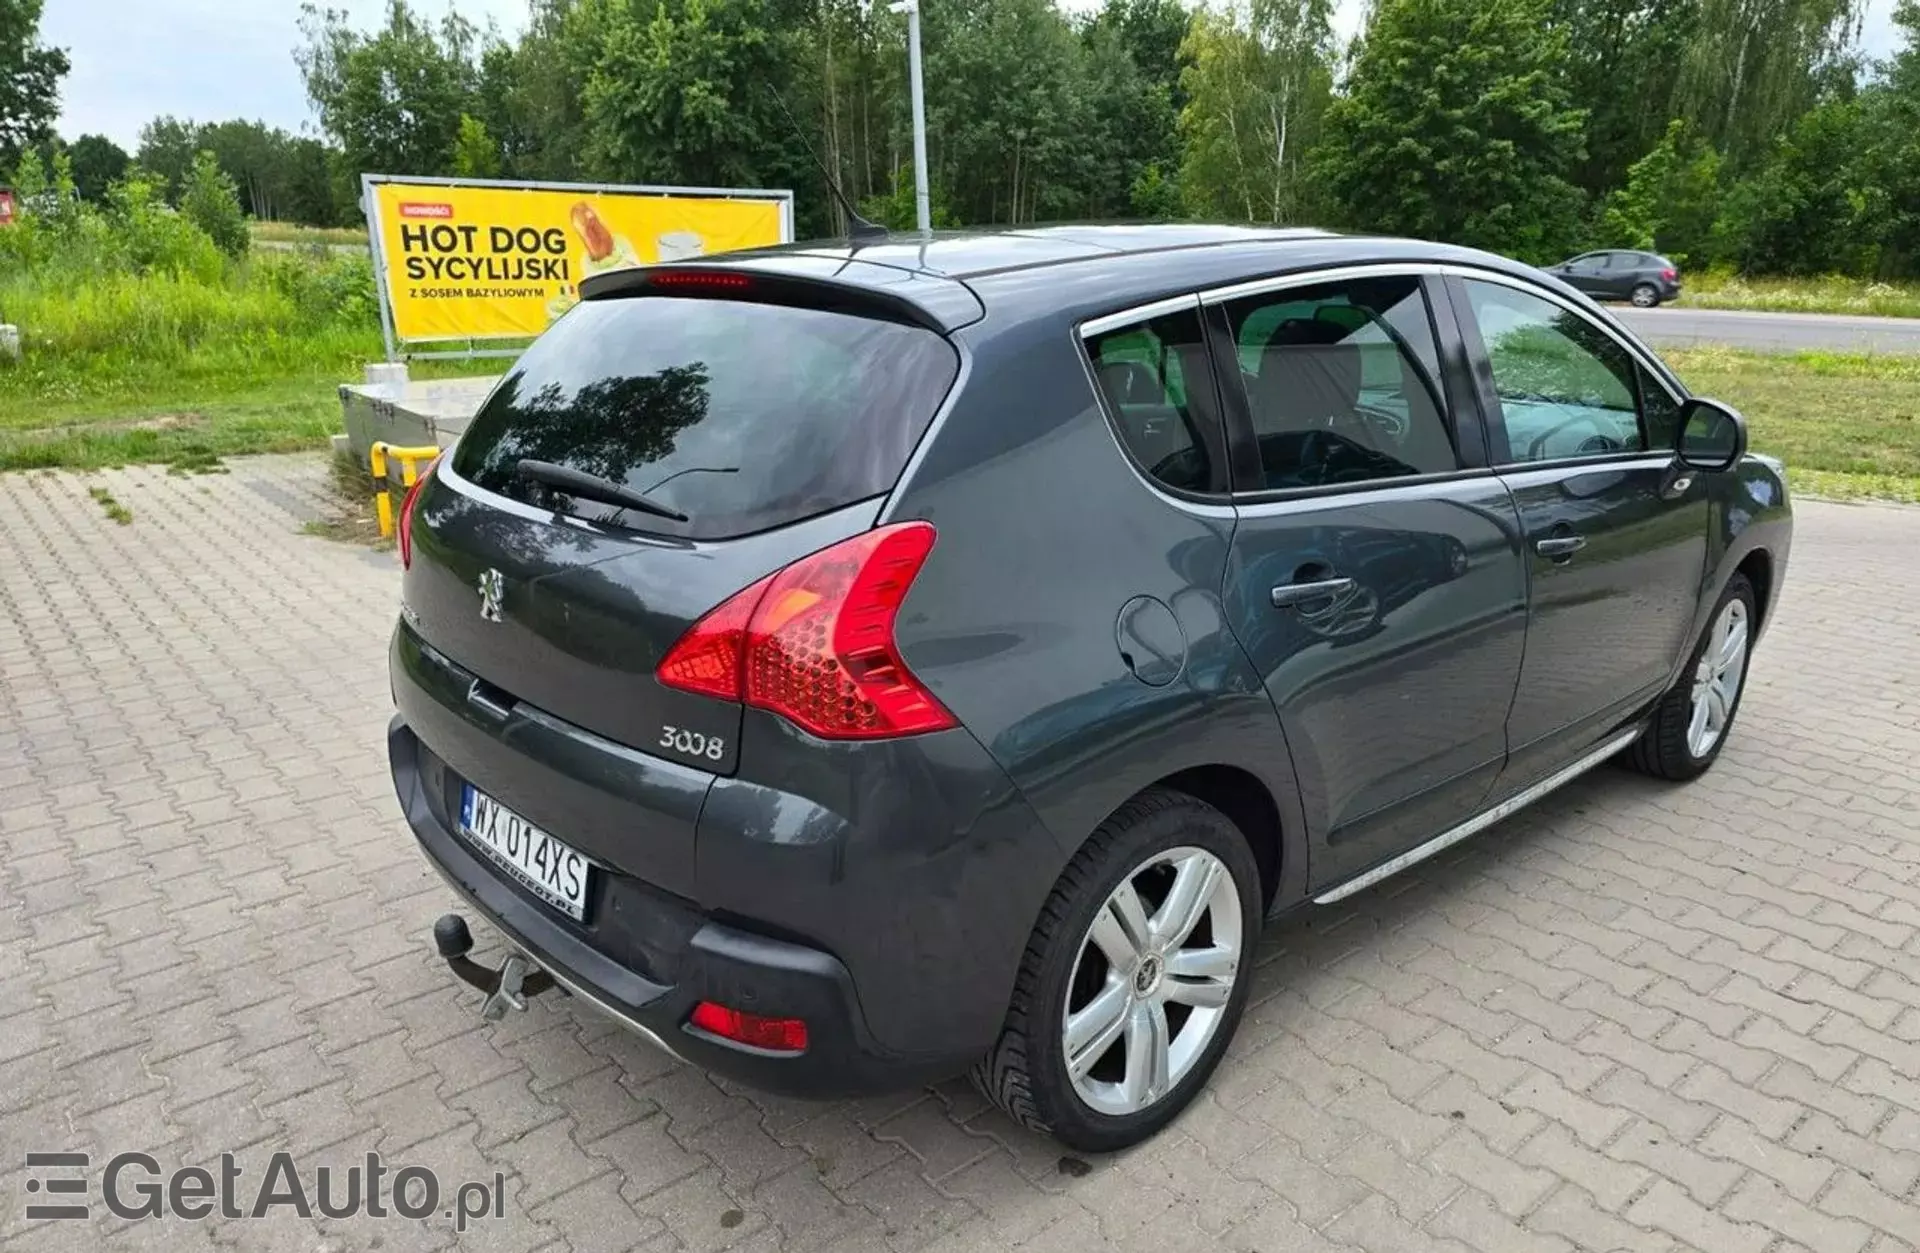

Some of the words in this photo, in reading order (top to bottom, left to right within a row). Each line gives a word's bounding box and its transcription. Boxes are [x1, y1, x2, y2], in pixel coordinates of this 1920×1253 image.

[401, 224, 477, 253] HOT
[489, 226, 567, 254] DOG
[406, 256, 568, 280] SYCYLIJSKI
[410, 288, 417, 298] Z
[420, 288, 463, 298] SOSEM
[466, 288, 545, 298] BAZYLIOWYM
[660, 725, 724, 760] 3008
[475, 793, 500, 846] WX
[507, 815, 582, 901] 014XS
